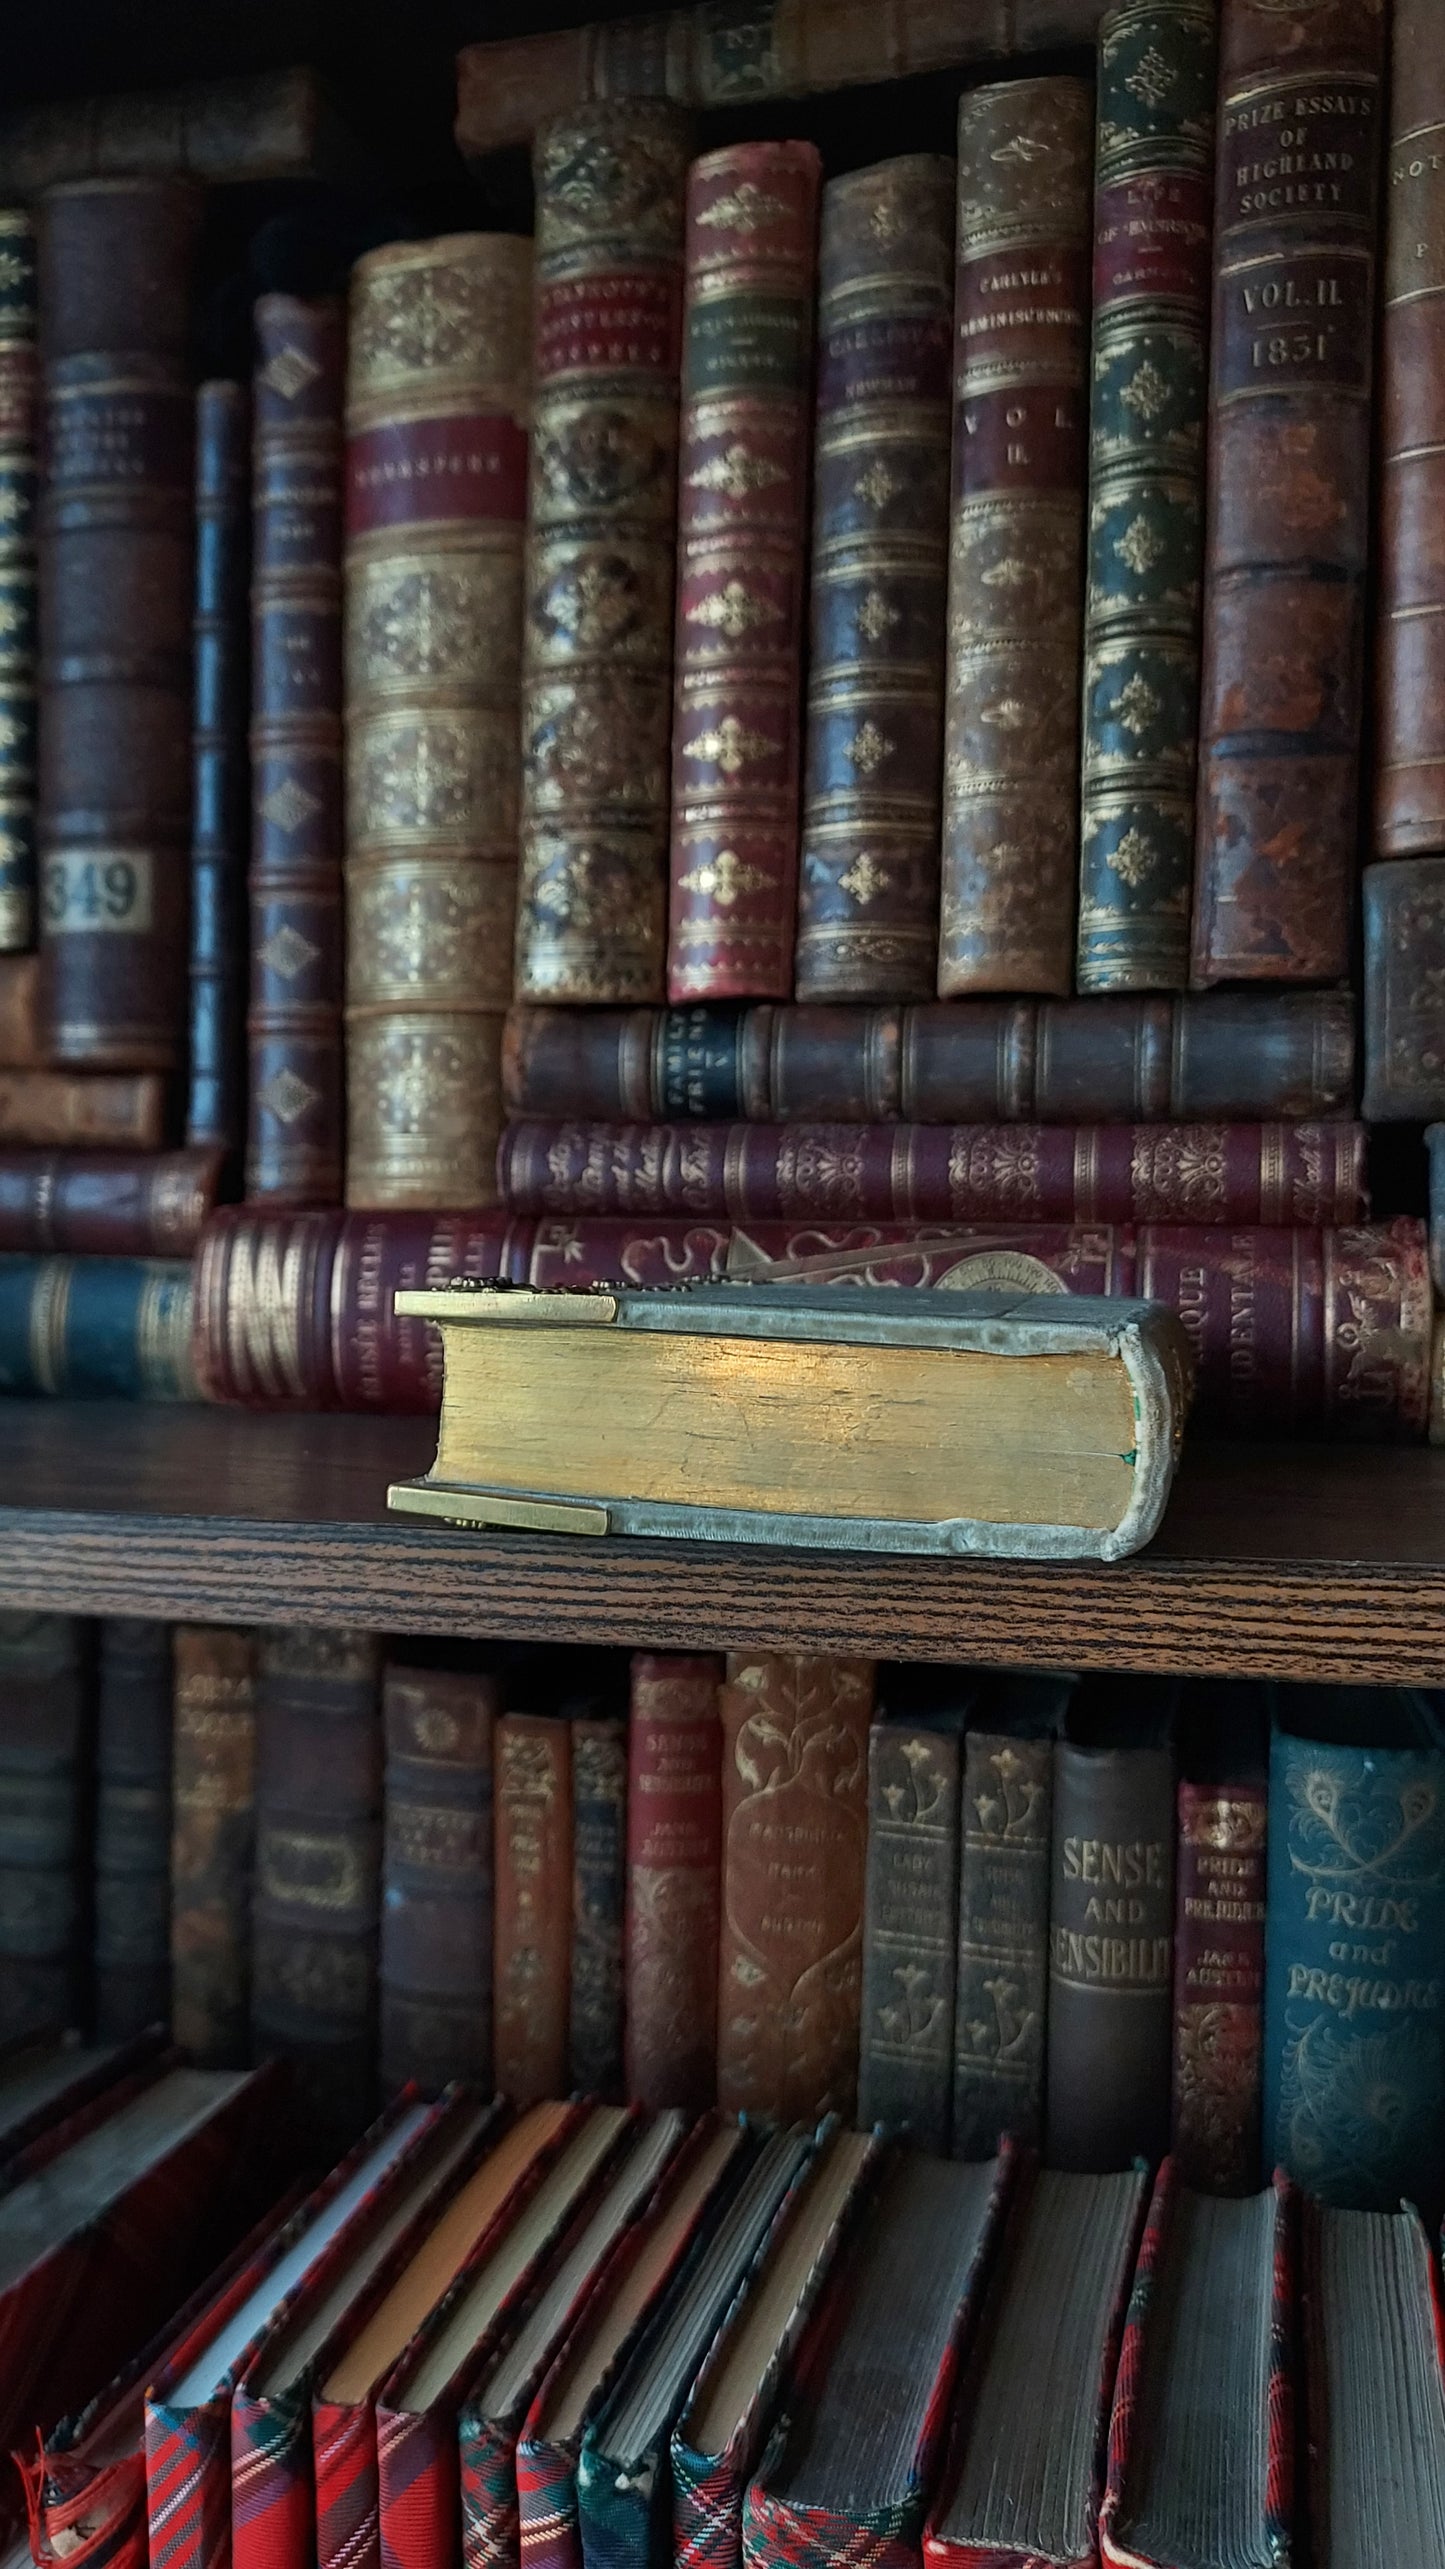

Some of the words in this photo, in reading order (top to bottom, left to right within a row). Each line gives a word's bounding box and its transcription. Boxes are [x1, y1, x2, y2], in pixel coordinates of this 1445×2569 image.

[1225, 101, 1285, 135] PRIZE
[1295, 96, 1371, 116] ESSAYS
[1279, 127, 1308, 148] OF
[1236, 153, 1354, 187] HIGHLAND
[1240, 183, 1342, 214] SOCIETY
[961, 307, 1084, 338] REMINISCENC
[668, 1012, 685, 1105] FAMILY
[687, 1007, 708, 1112] FRIEND
[1063, 1836, 1165, 1888] SENSE
[1208, 1879, 1247, 1898] AND
[1084, 1896, 1144, 1924] AND
[1305, 1886, 1420, 1934] PRIDE
[1050, 1926, 1170, 1980] SENSIBILIT
[1329, 1938, 1398, 1968] and
